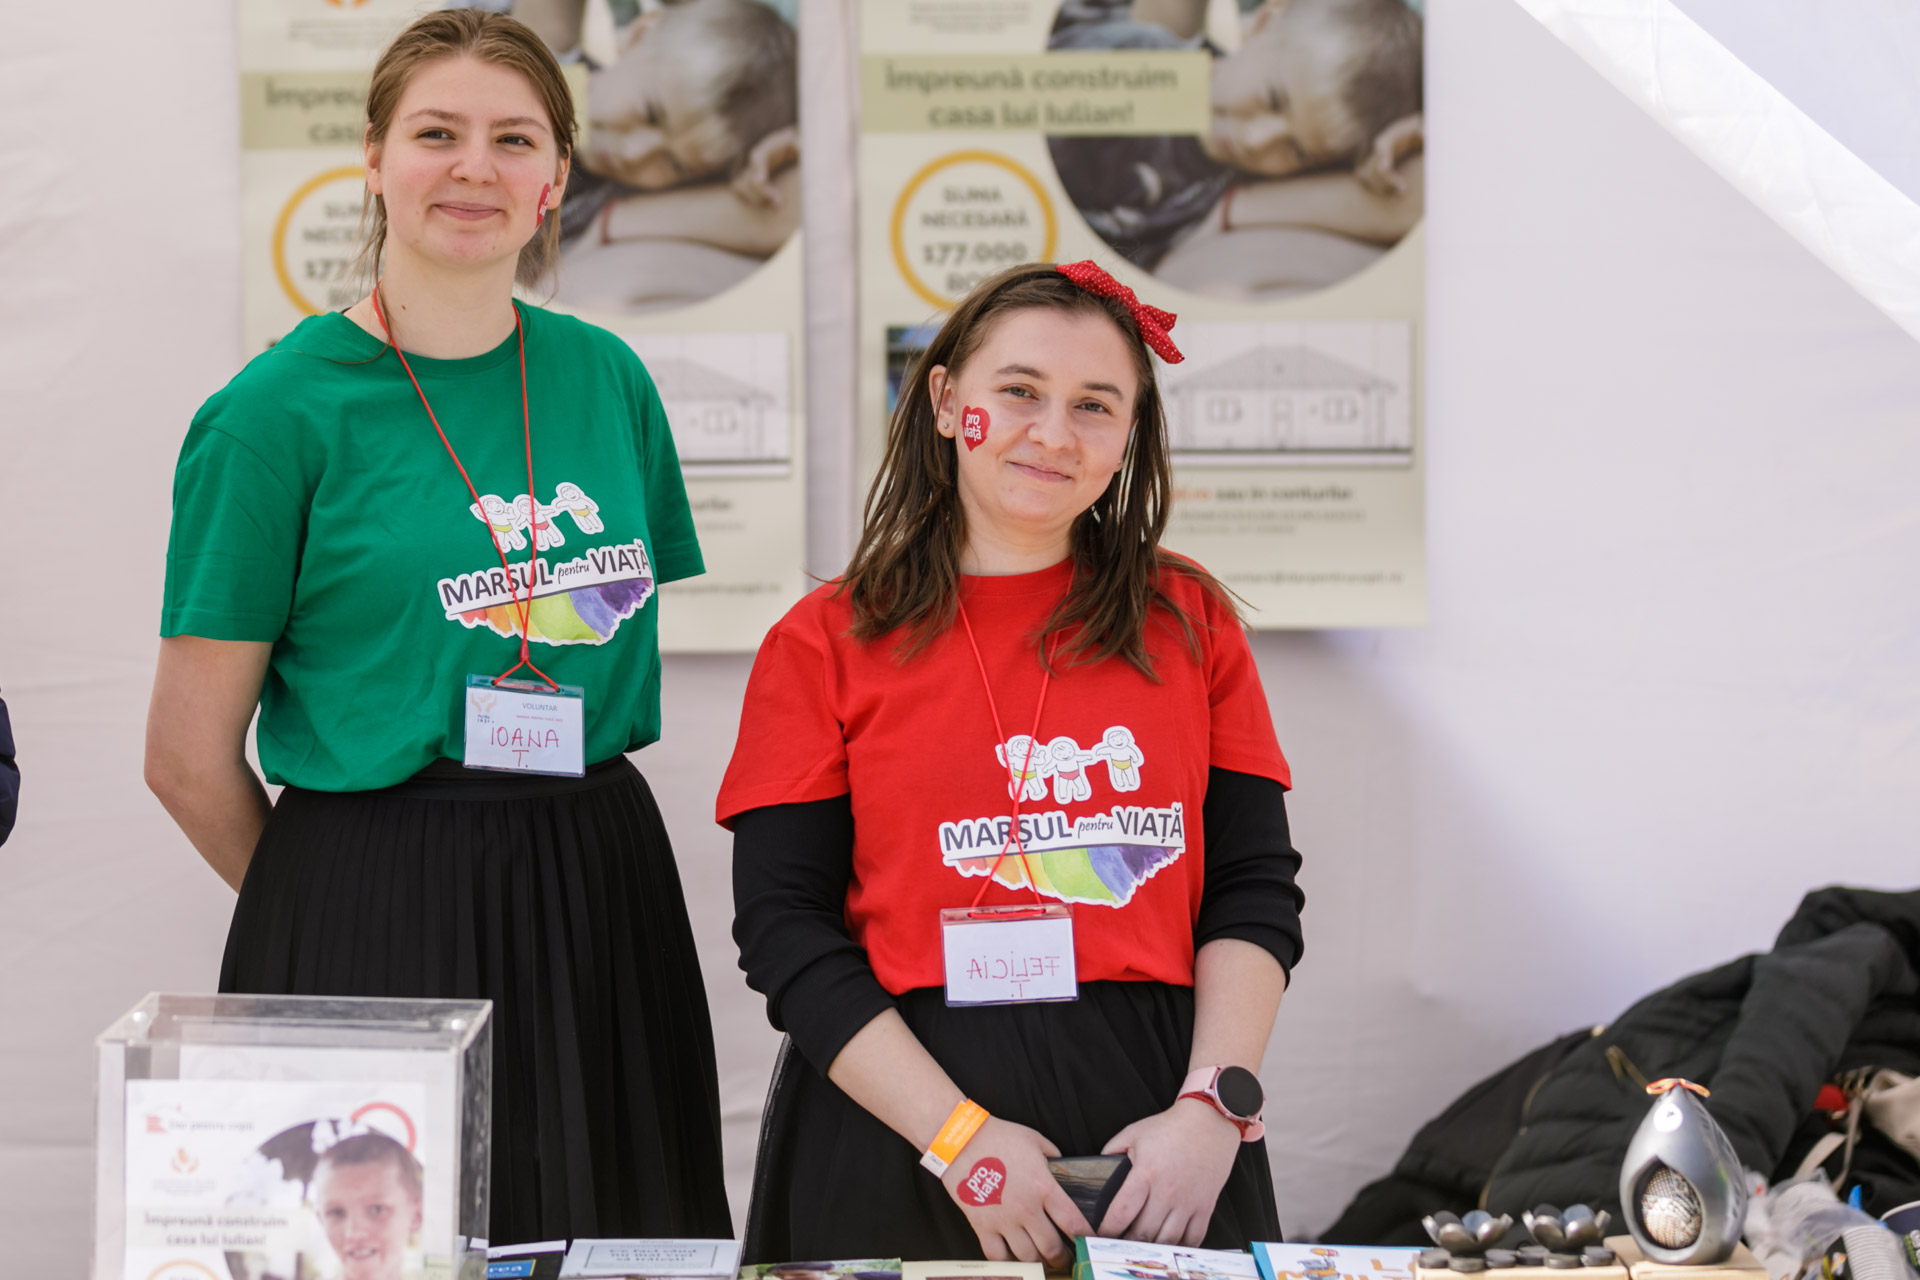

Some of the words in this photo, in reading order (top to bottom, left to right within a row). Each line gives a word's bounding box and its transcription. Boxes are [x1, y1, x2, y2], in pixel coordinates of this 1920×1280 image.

[885, 60, 1025, 95] Împreună
[1032, 63, 1179, 91] construim
[929, 106, 995, 128] casa
[1002, 101, 1038, 127] lui
[1045, 101, 1135, 127] Iulian!
[308, 123, 363, 143] cas
[944, 187, 1003, 203] SUMA
[922, 207, 1029, 228] NECESARĂ
[966, 413, 980, 427] pro
[442, 563, 553, 607] MARȘUL
[557, 562, 590, 585] pentru
[590, 542, 650, 576] VIAȚĂ
[522, 702, 558, 712] VOLUNTAR
[511, 749, 530, 769] T.
[943, 815, 1073, 852] MARȘUL
[1077, 819, 1114, 839] pentru
[1115, 807, 1183, 844] VIAȚĂ
[966, 1166, 989, 1193] pro
[973, 1169, 1003, 1204] viață
[217, 1213, 289, 1228] construim
[166, 1235, 196, 1246] casa
